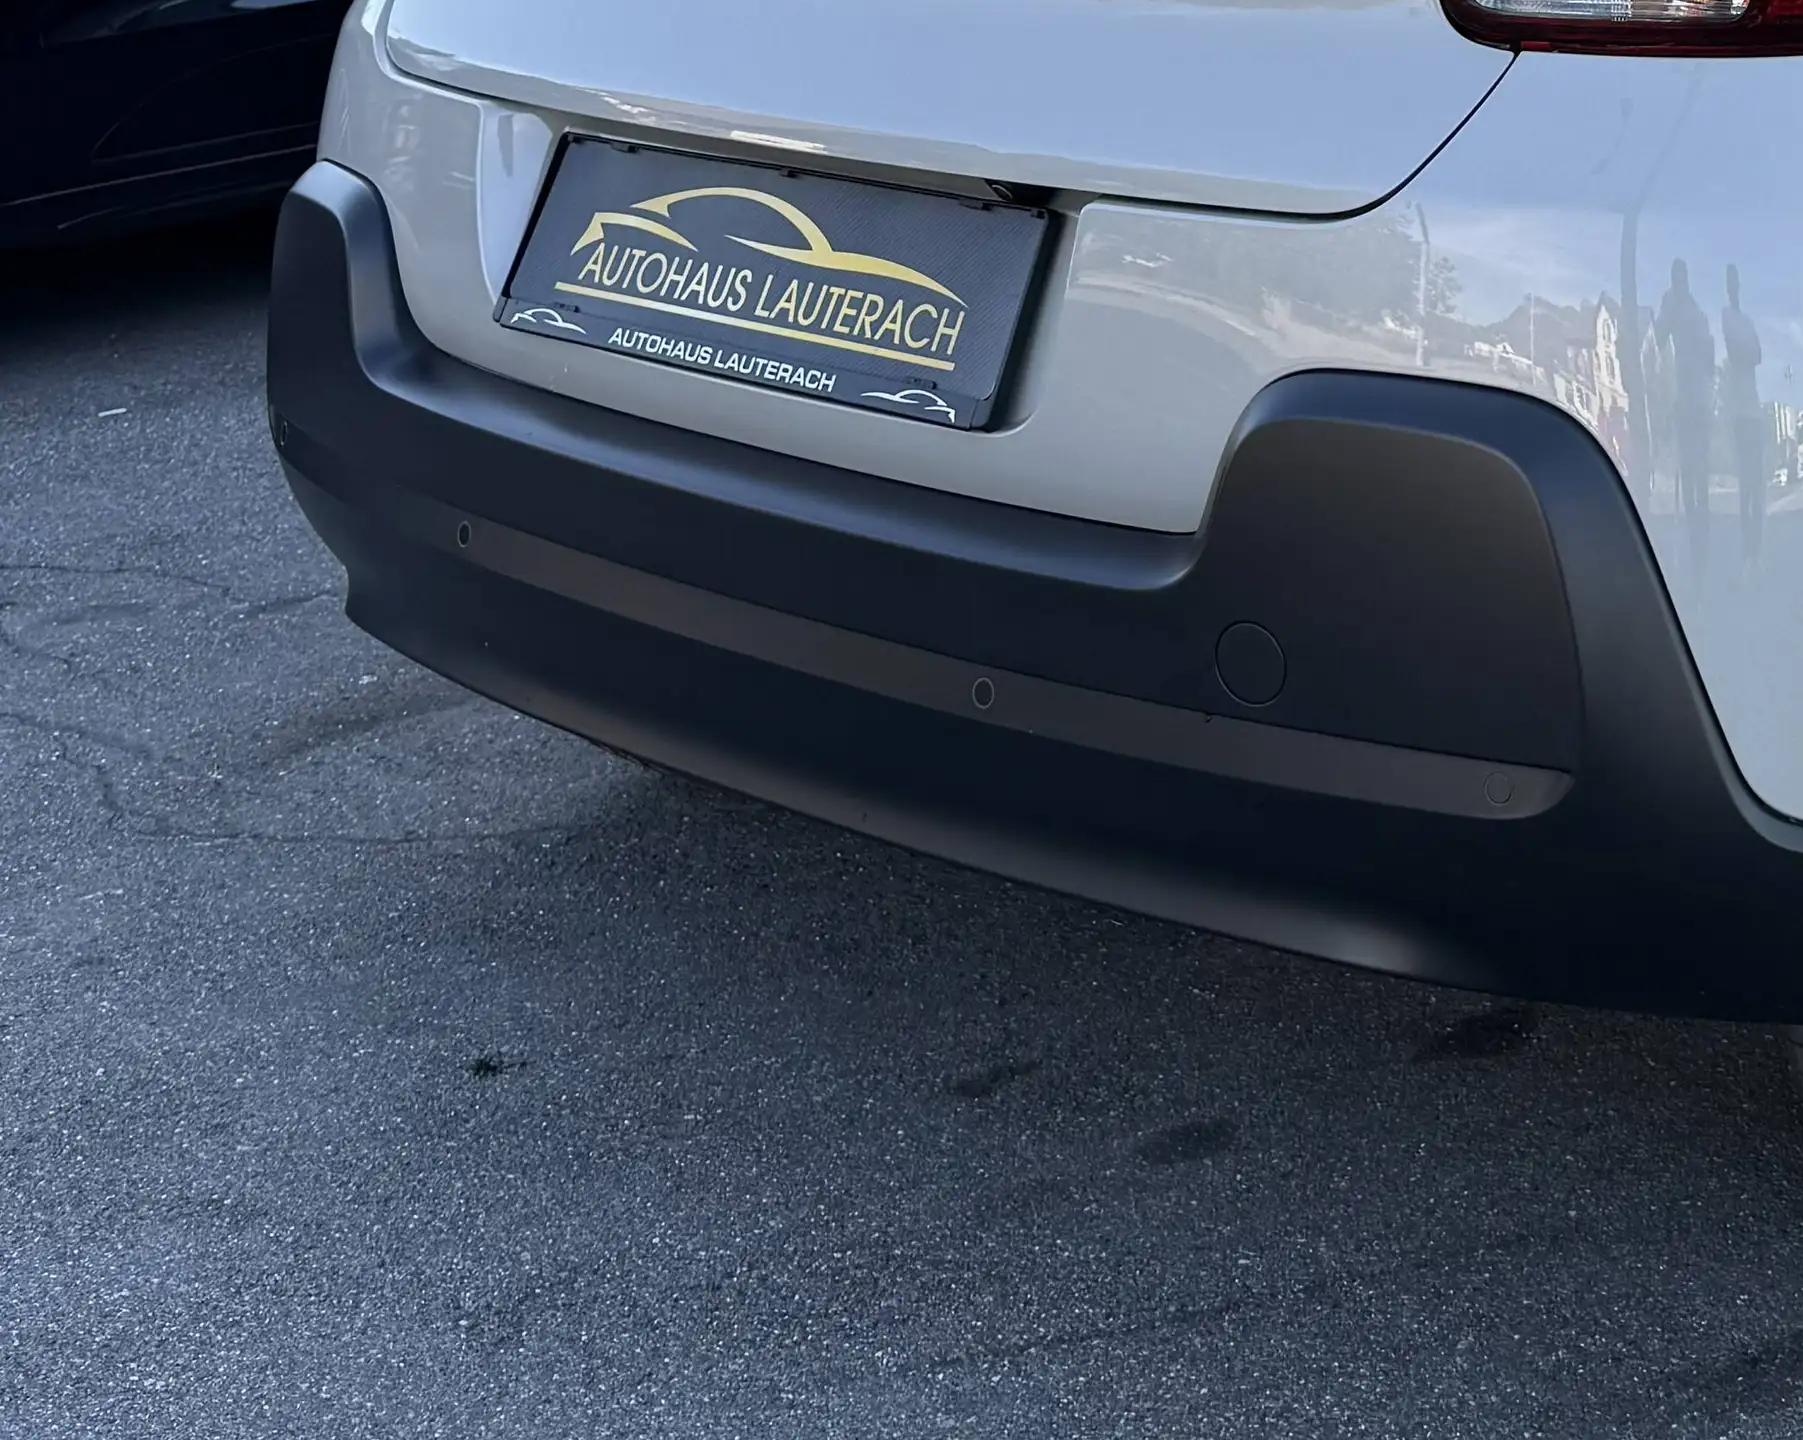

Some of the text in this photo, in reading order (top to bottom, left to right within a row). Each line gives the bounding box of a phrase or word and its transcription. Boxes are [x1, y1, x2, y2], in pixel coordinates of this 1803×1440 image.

[578, 242, 966, 355] AUTOHAUS LAUTERACH
[607, 326, 837, 392] AUTOHAUS LAUTERACH
